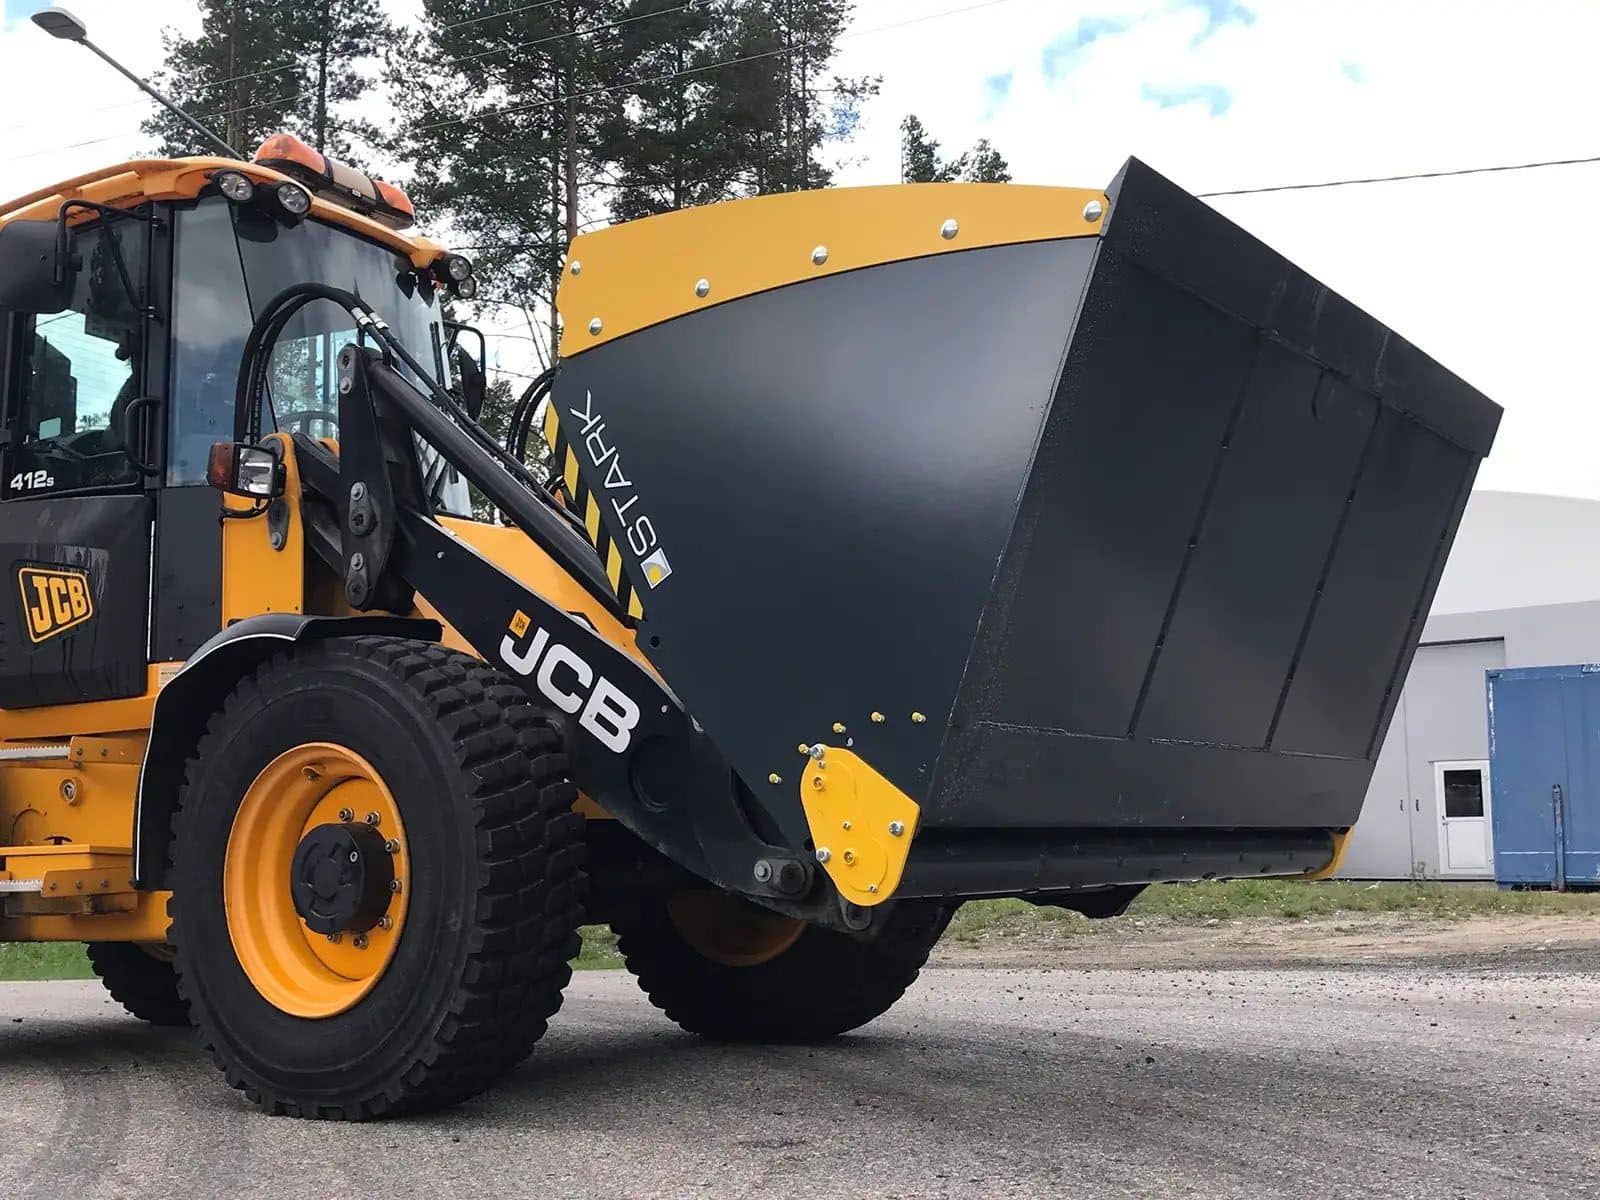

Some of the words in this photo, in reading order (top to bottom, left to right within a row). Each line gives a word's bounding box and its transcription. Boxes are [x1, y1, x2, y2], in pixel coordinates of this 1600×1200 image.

[570, 389, 657, 556] STARK
[31, 575, 87, 633] JCB
[500, 626, 640, 754] JCB
